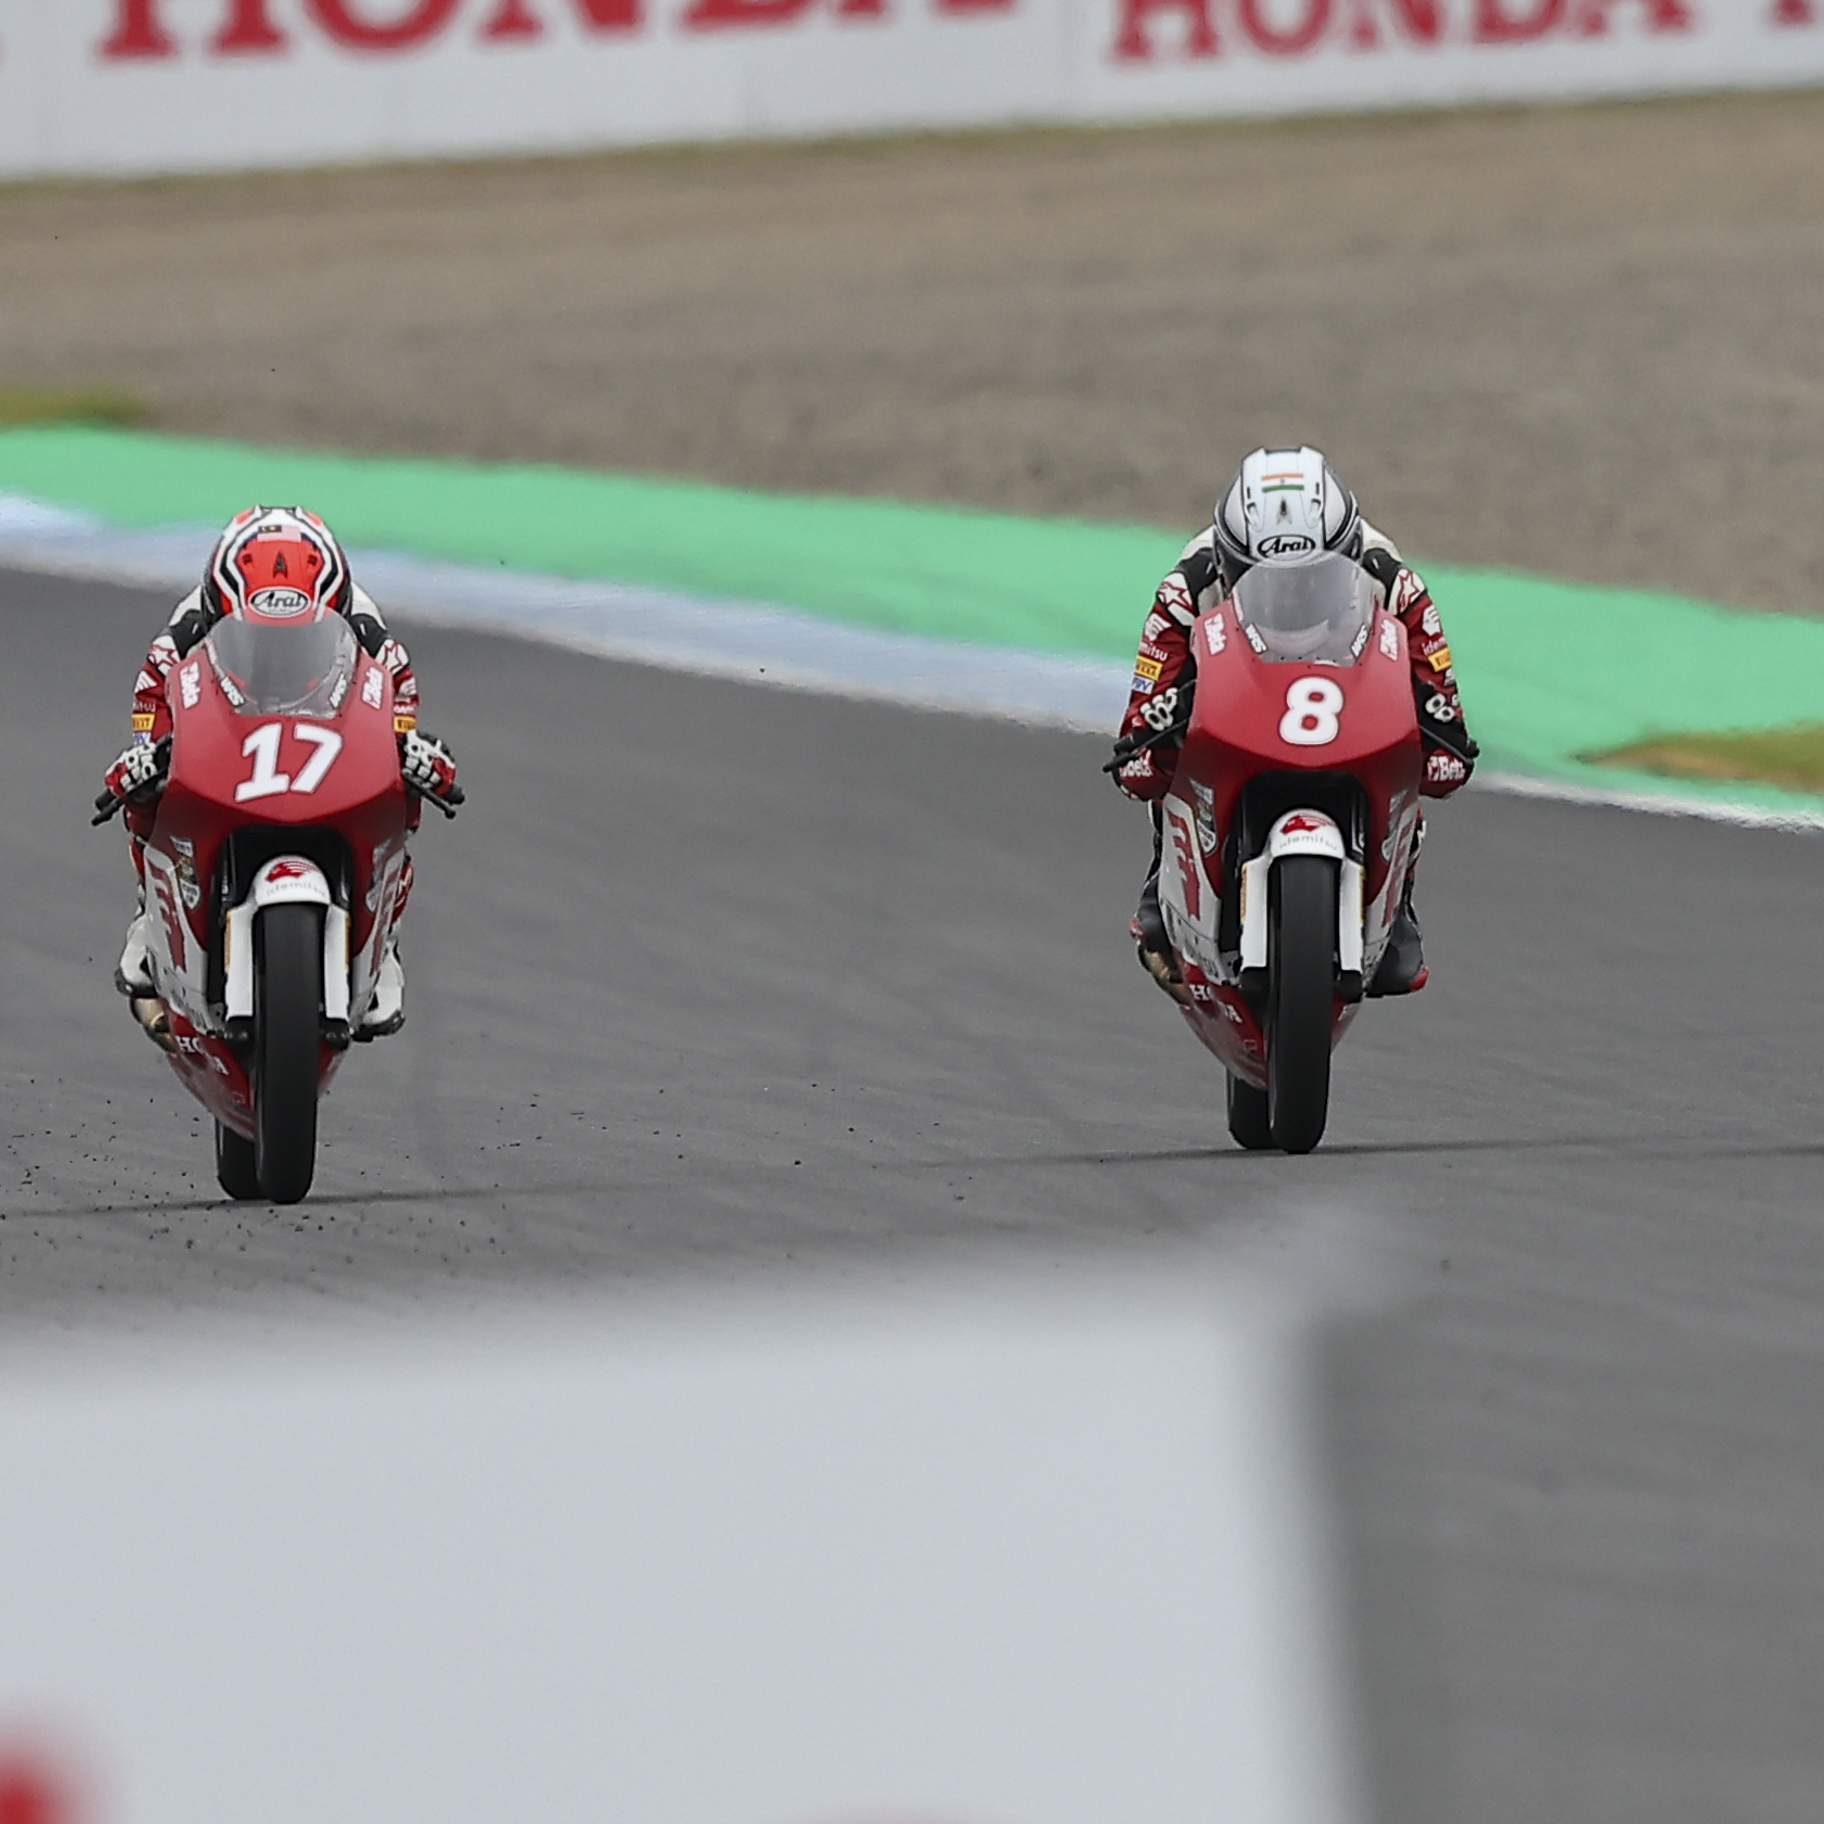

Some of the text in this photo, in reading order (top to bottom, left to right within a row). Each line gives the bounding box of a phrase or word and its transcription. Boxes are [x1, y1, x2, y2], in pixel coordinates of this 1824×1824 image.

[1266, 537, 1311, 554] Arai
[253, 589, 303, 608] Arai
[1279, 675, 1345, 745] 8
[234, 722, 345, 803] 17
